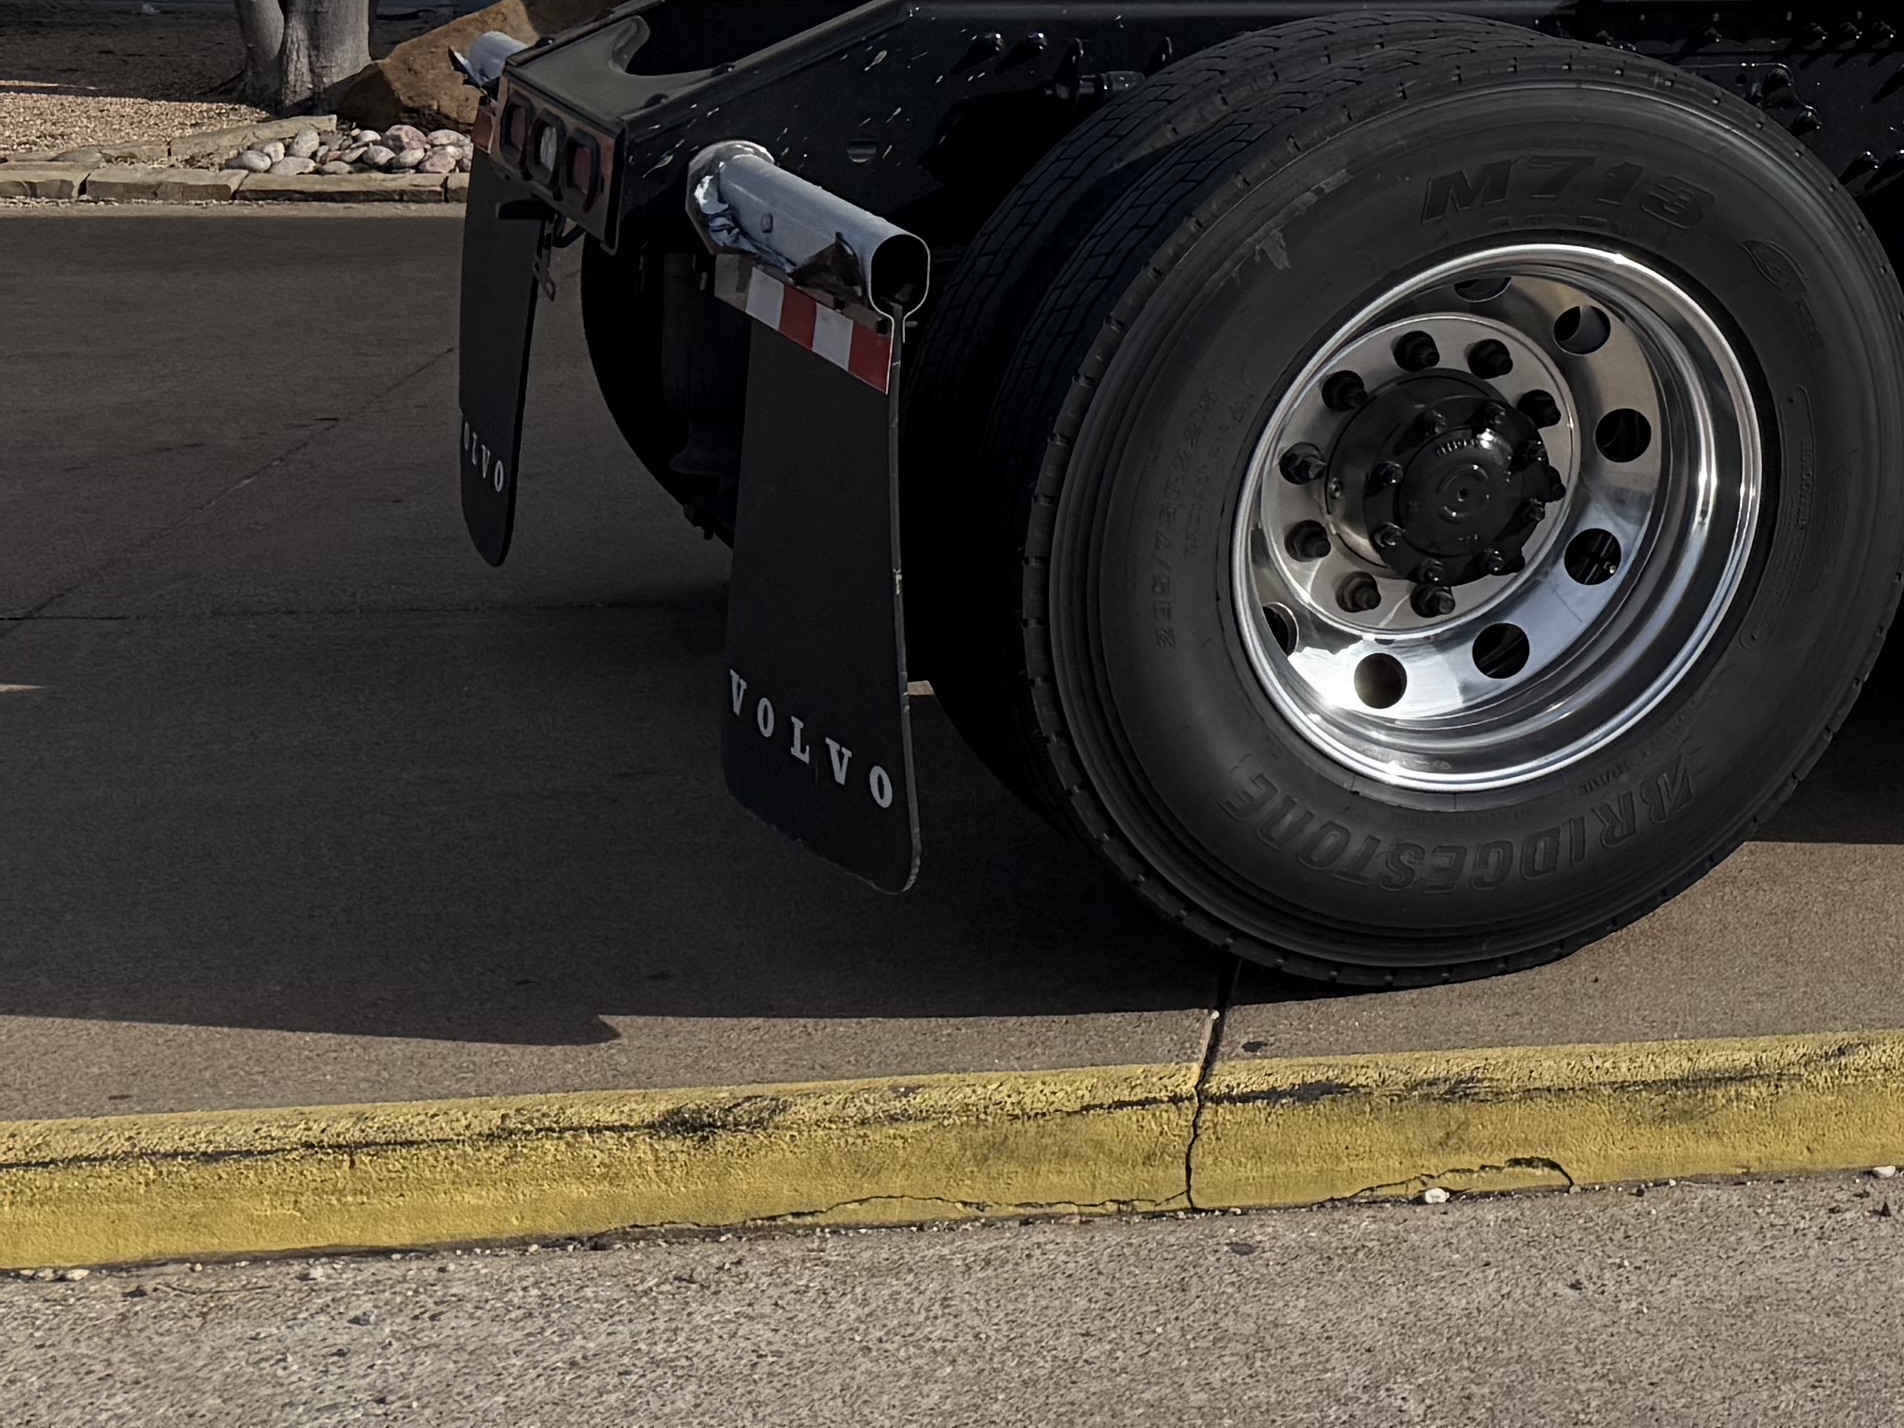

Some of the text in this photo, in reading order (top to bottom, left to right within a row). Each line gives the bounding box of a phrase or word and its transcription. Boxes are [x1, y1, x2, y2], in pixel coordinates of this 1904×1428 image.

[1420, 155, 1717, 230] M713
[729, 668, 893, 809] VOLVO
[1217, 752, 1697, 894] BRIDGESTONE
